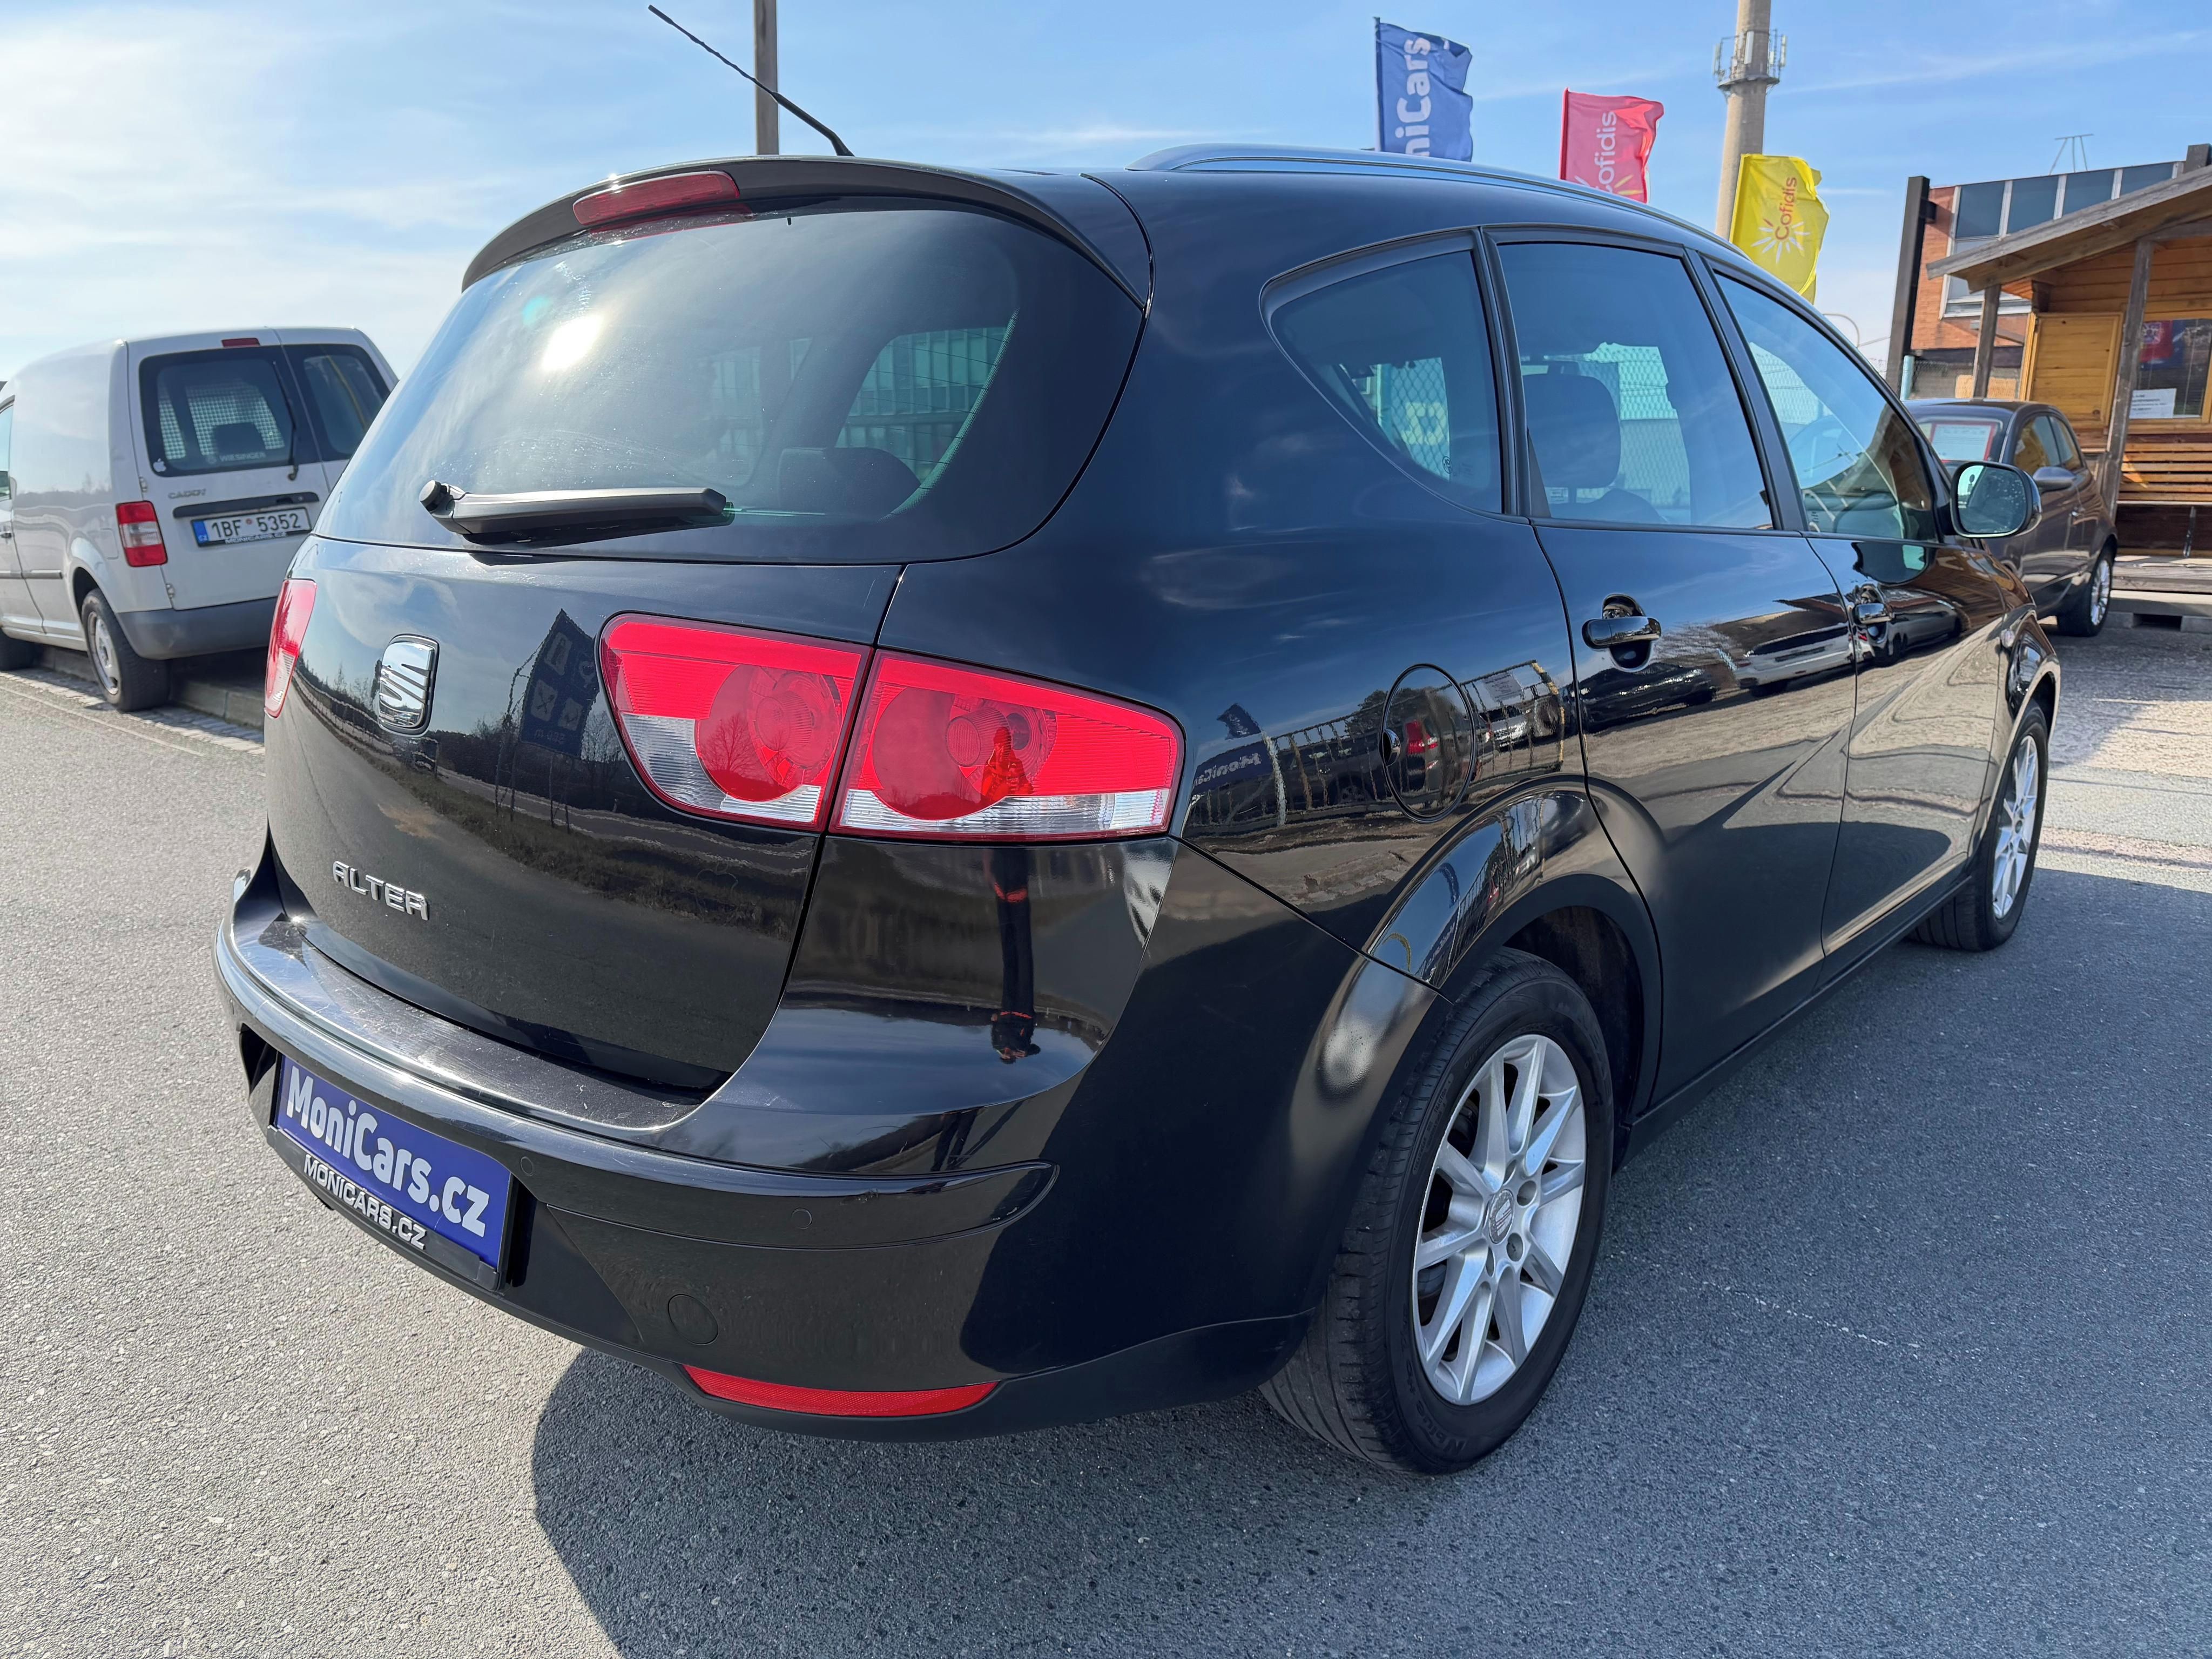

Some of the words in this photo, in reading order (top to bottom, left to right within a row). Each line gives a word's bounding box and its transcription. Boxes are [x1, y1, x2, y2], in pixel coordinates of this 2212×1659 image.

[1594, 112, 1617, 193] ofidis
[1775, 177, 1798, 240] Cofidis
[212, 519, 241, 538] 1BF
[256, 513, 301, 532] 5352
[332, 860, 429, 921] ALTEA
[286, 1065, 490, 1238] MoniCars.cz
[304, 1154, 427, 1251] MONICARS.CZ
